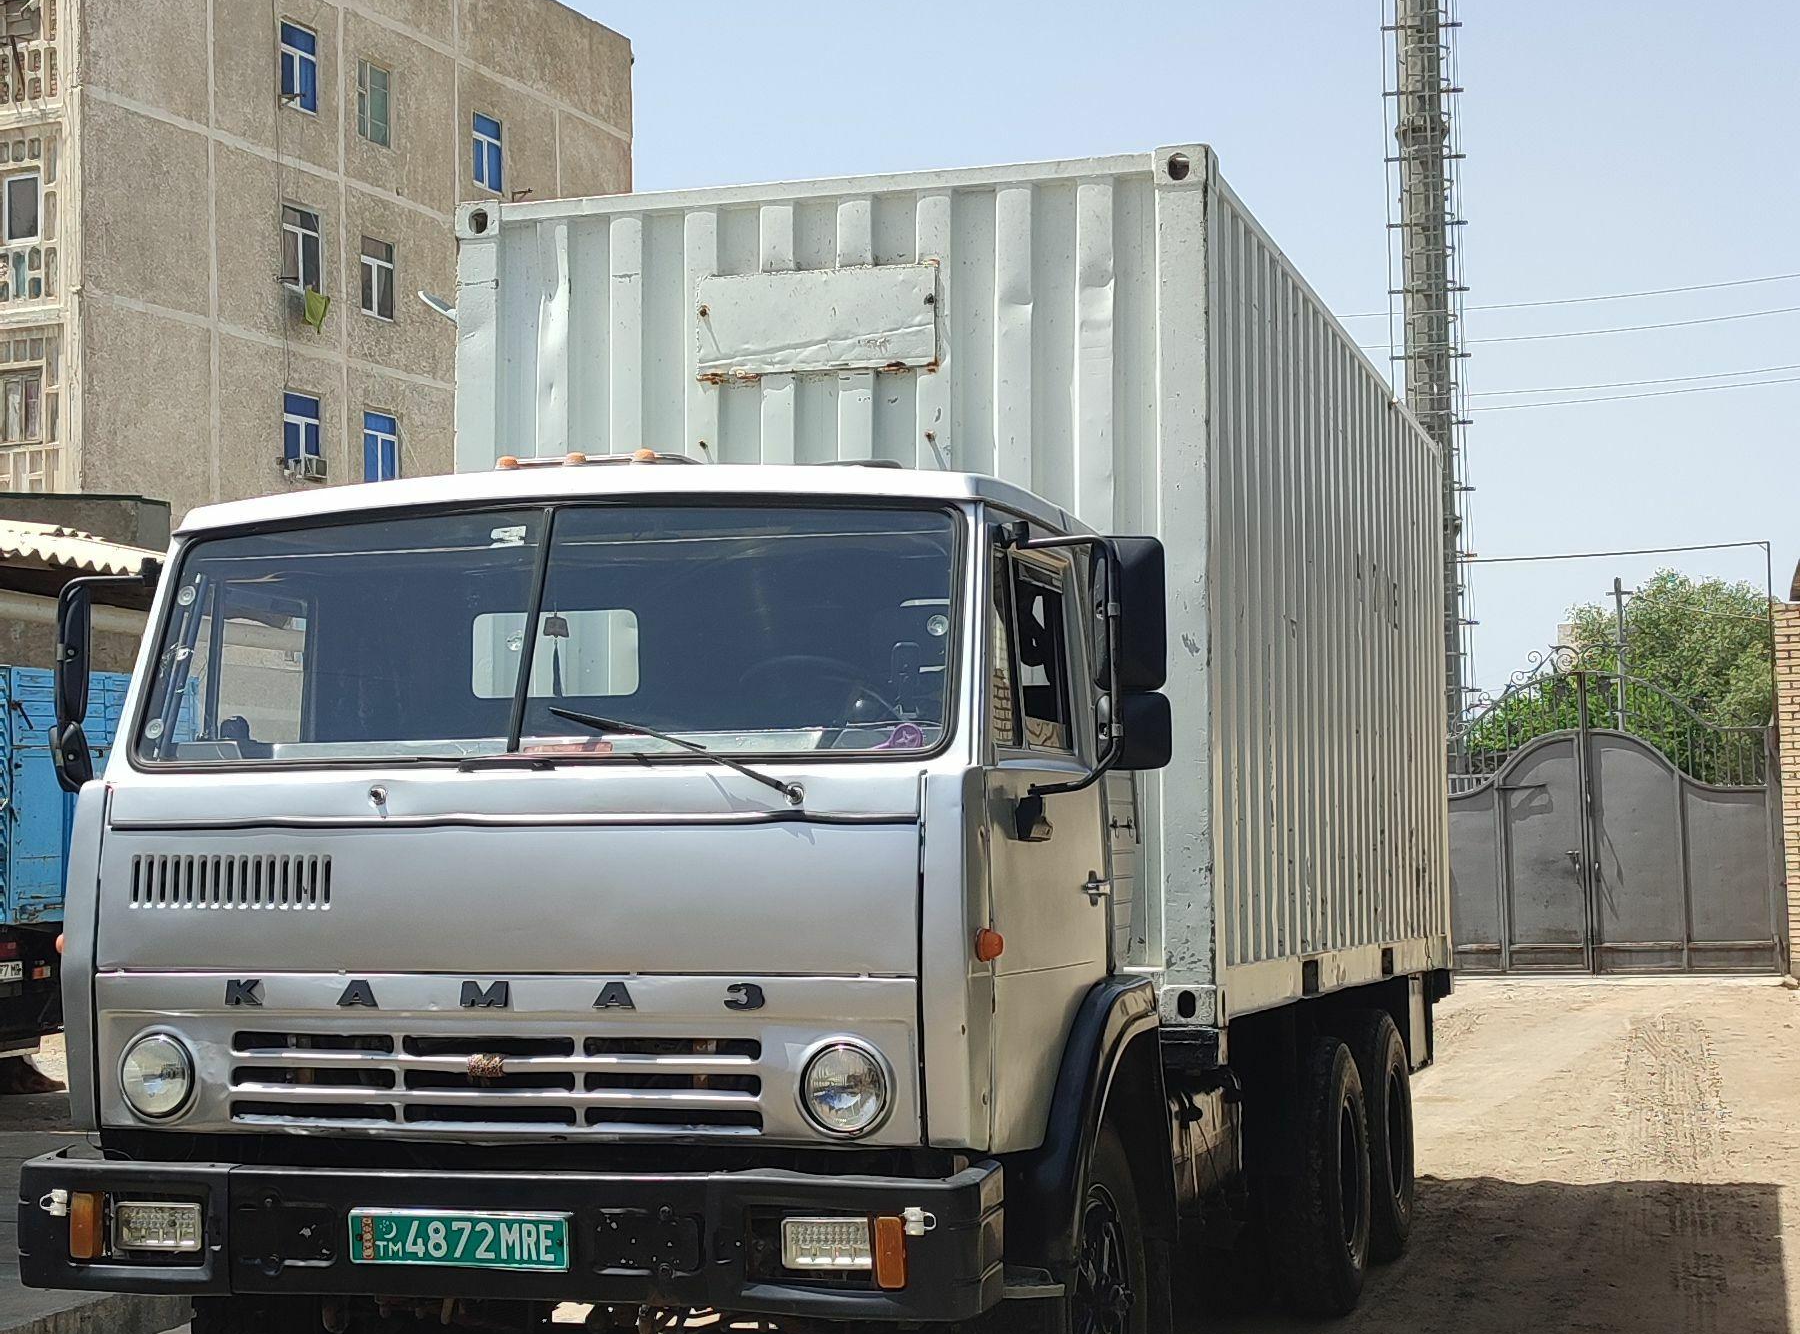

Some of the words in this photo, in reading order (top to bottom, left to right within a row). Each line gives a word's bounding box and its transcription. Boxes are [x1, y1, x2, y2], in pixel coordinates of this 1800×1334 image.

[225, 978, 764, 1011] КАМАЗ
[375, 1240, 402, 1257] TM
[405, 1220, 495, 1259] 4872
[500, 1223, 554, 1261] MRE
